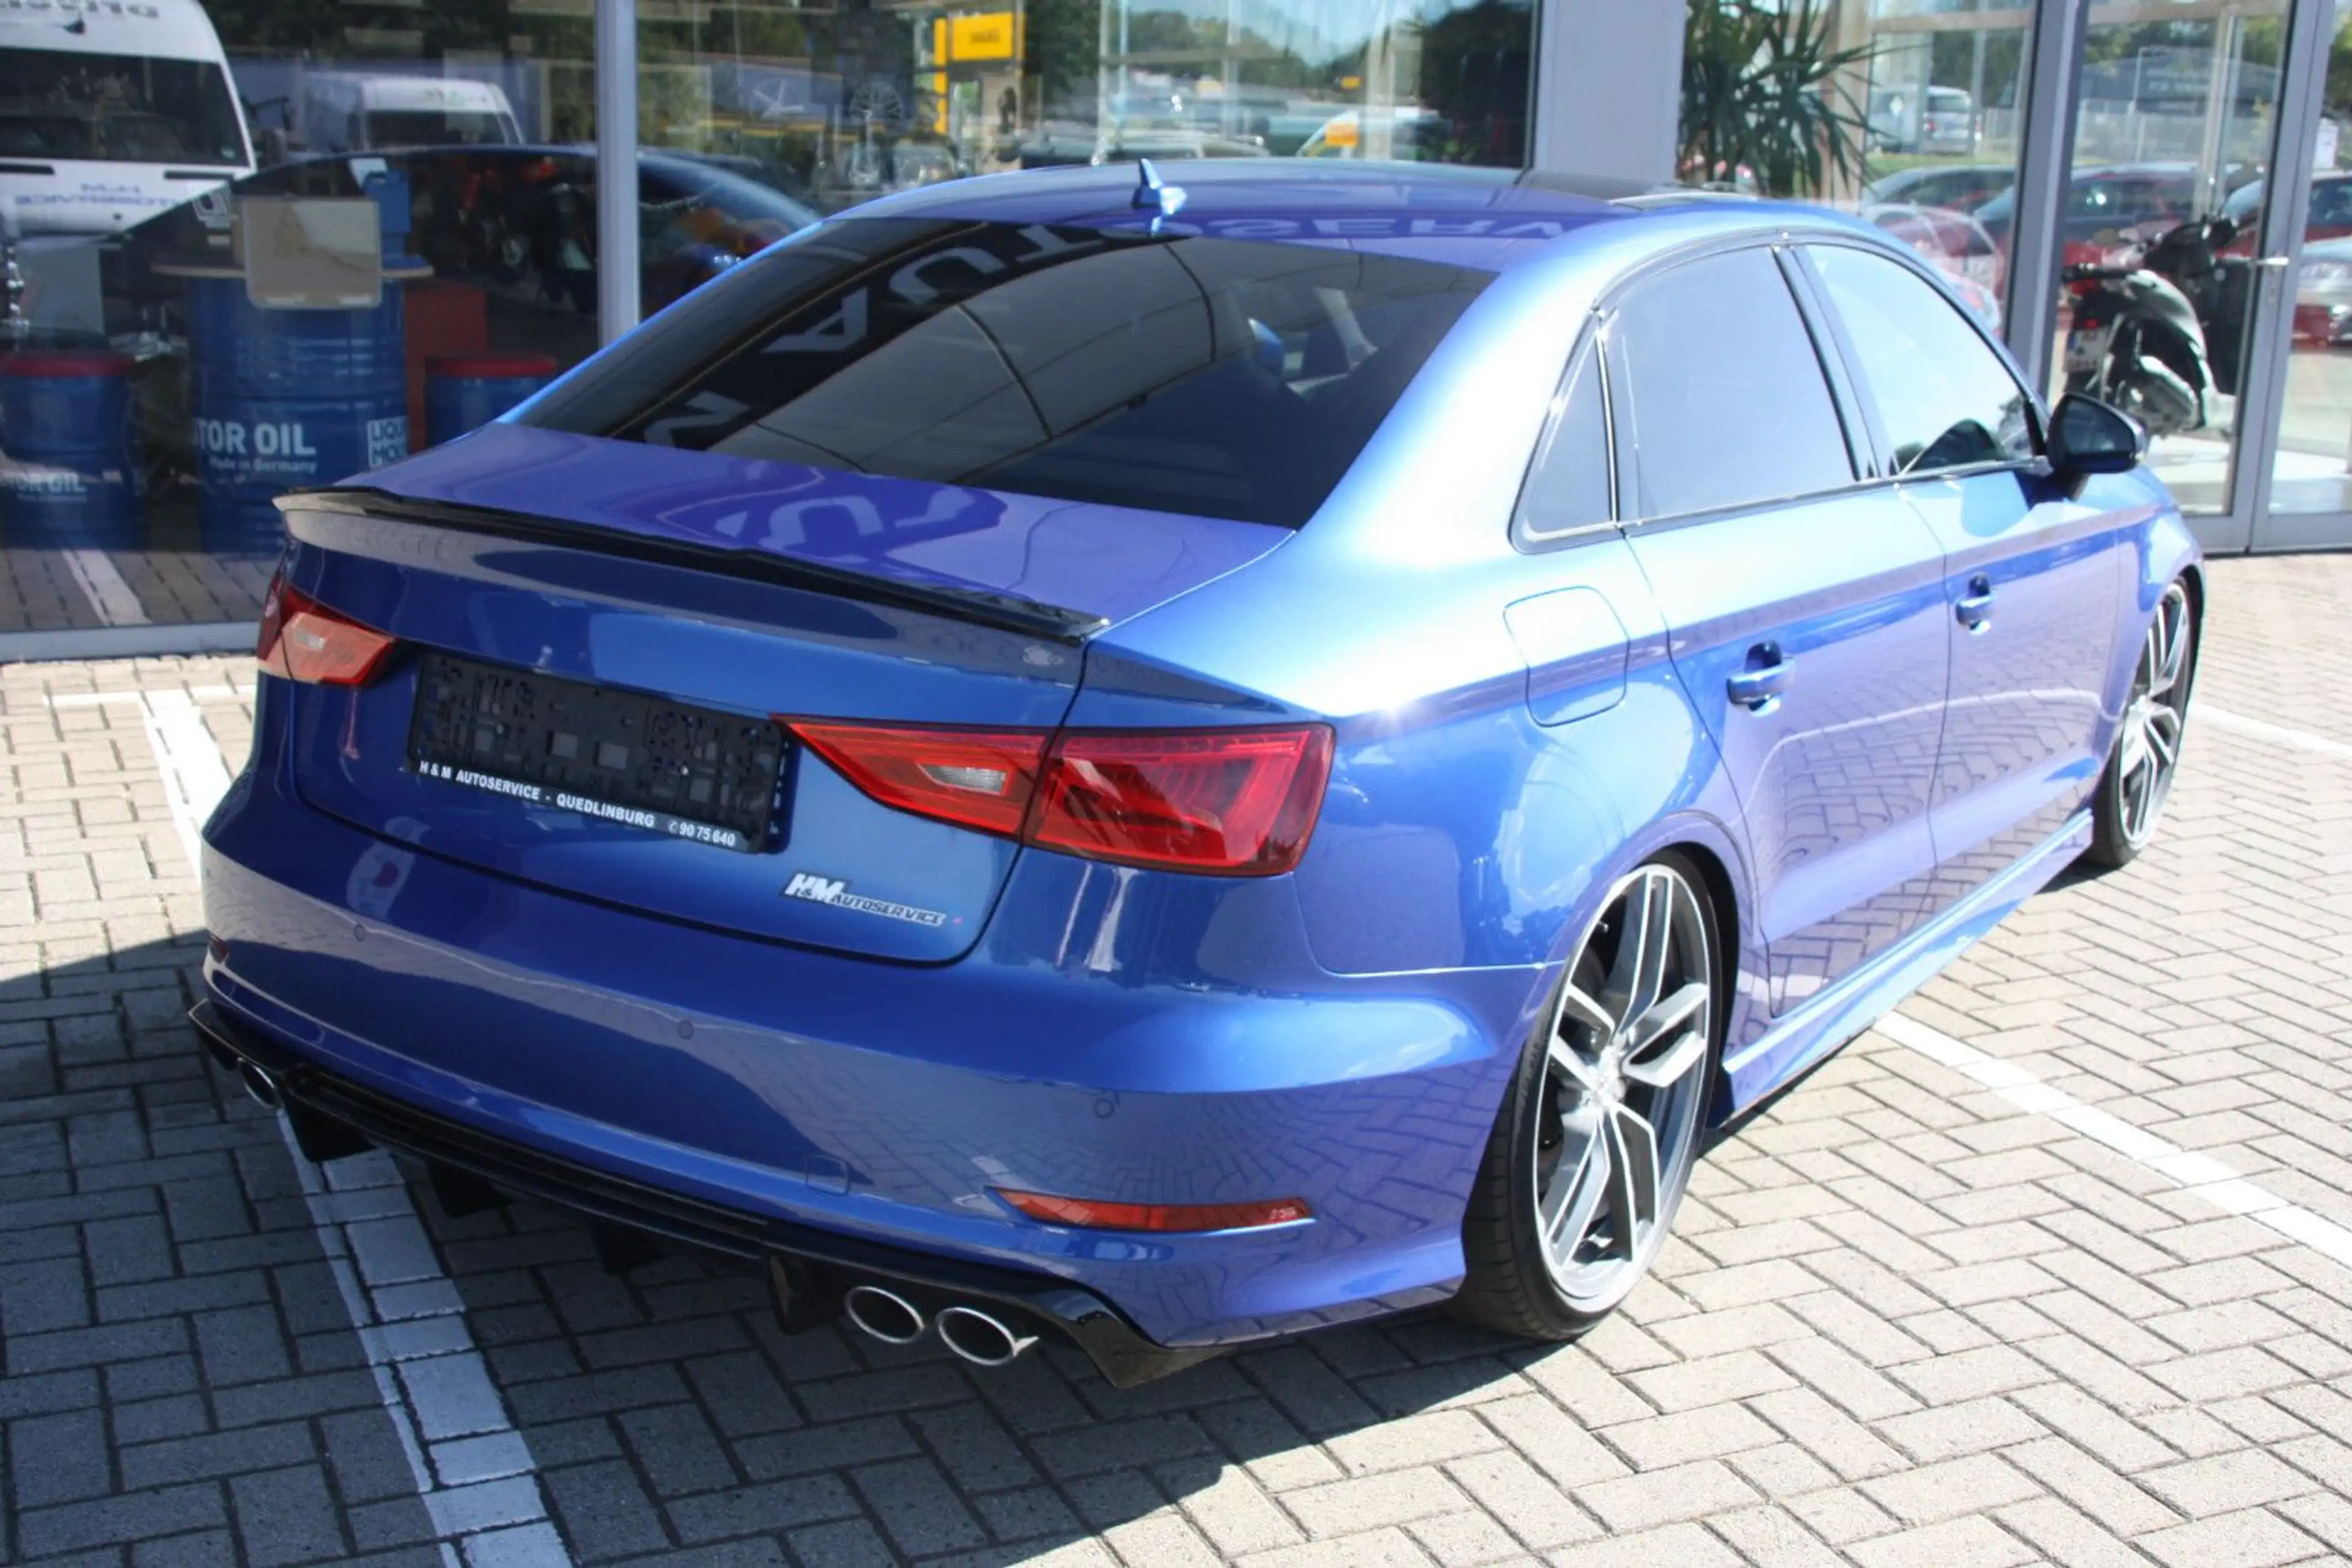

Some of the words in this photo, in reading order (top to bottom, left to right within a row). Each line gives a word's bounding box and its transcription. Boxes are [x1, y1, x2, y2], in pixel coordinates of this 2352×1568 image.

[254, 421, 316, 457] OIL
[420, 760, 429, 774] H
[441, 766, 452, 779] M
[456, 769, 540, 800] AUTOSERVICE
[557, 793, 655, 827] QUEDLINBURG
[831, 892, 946, 927] AUTOSERVICE
